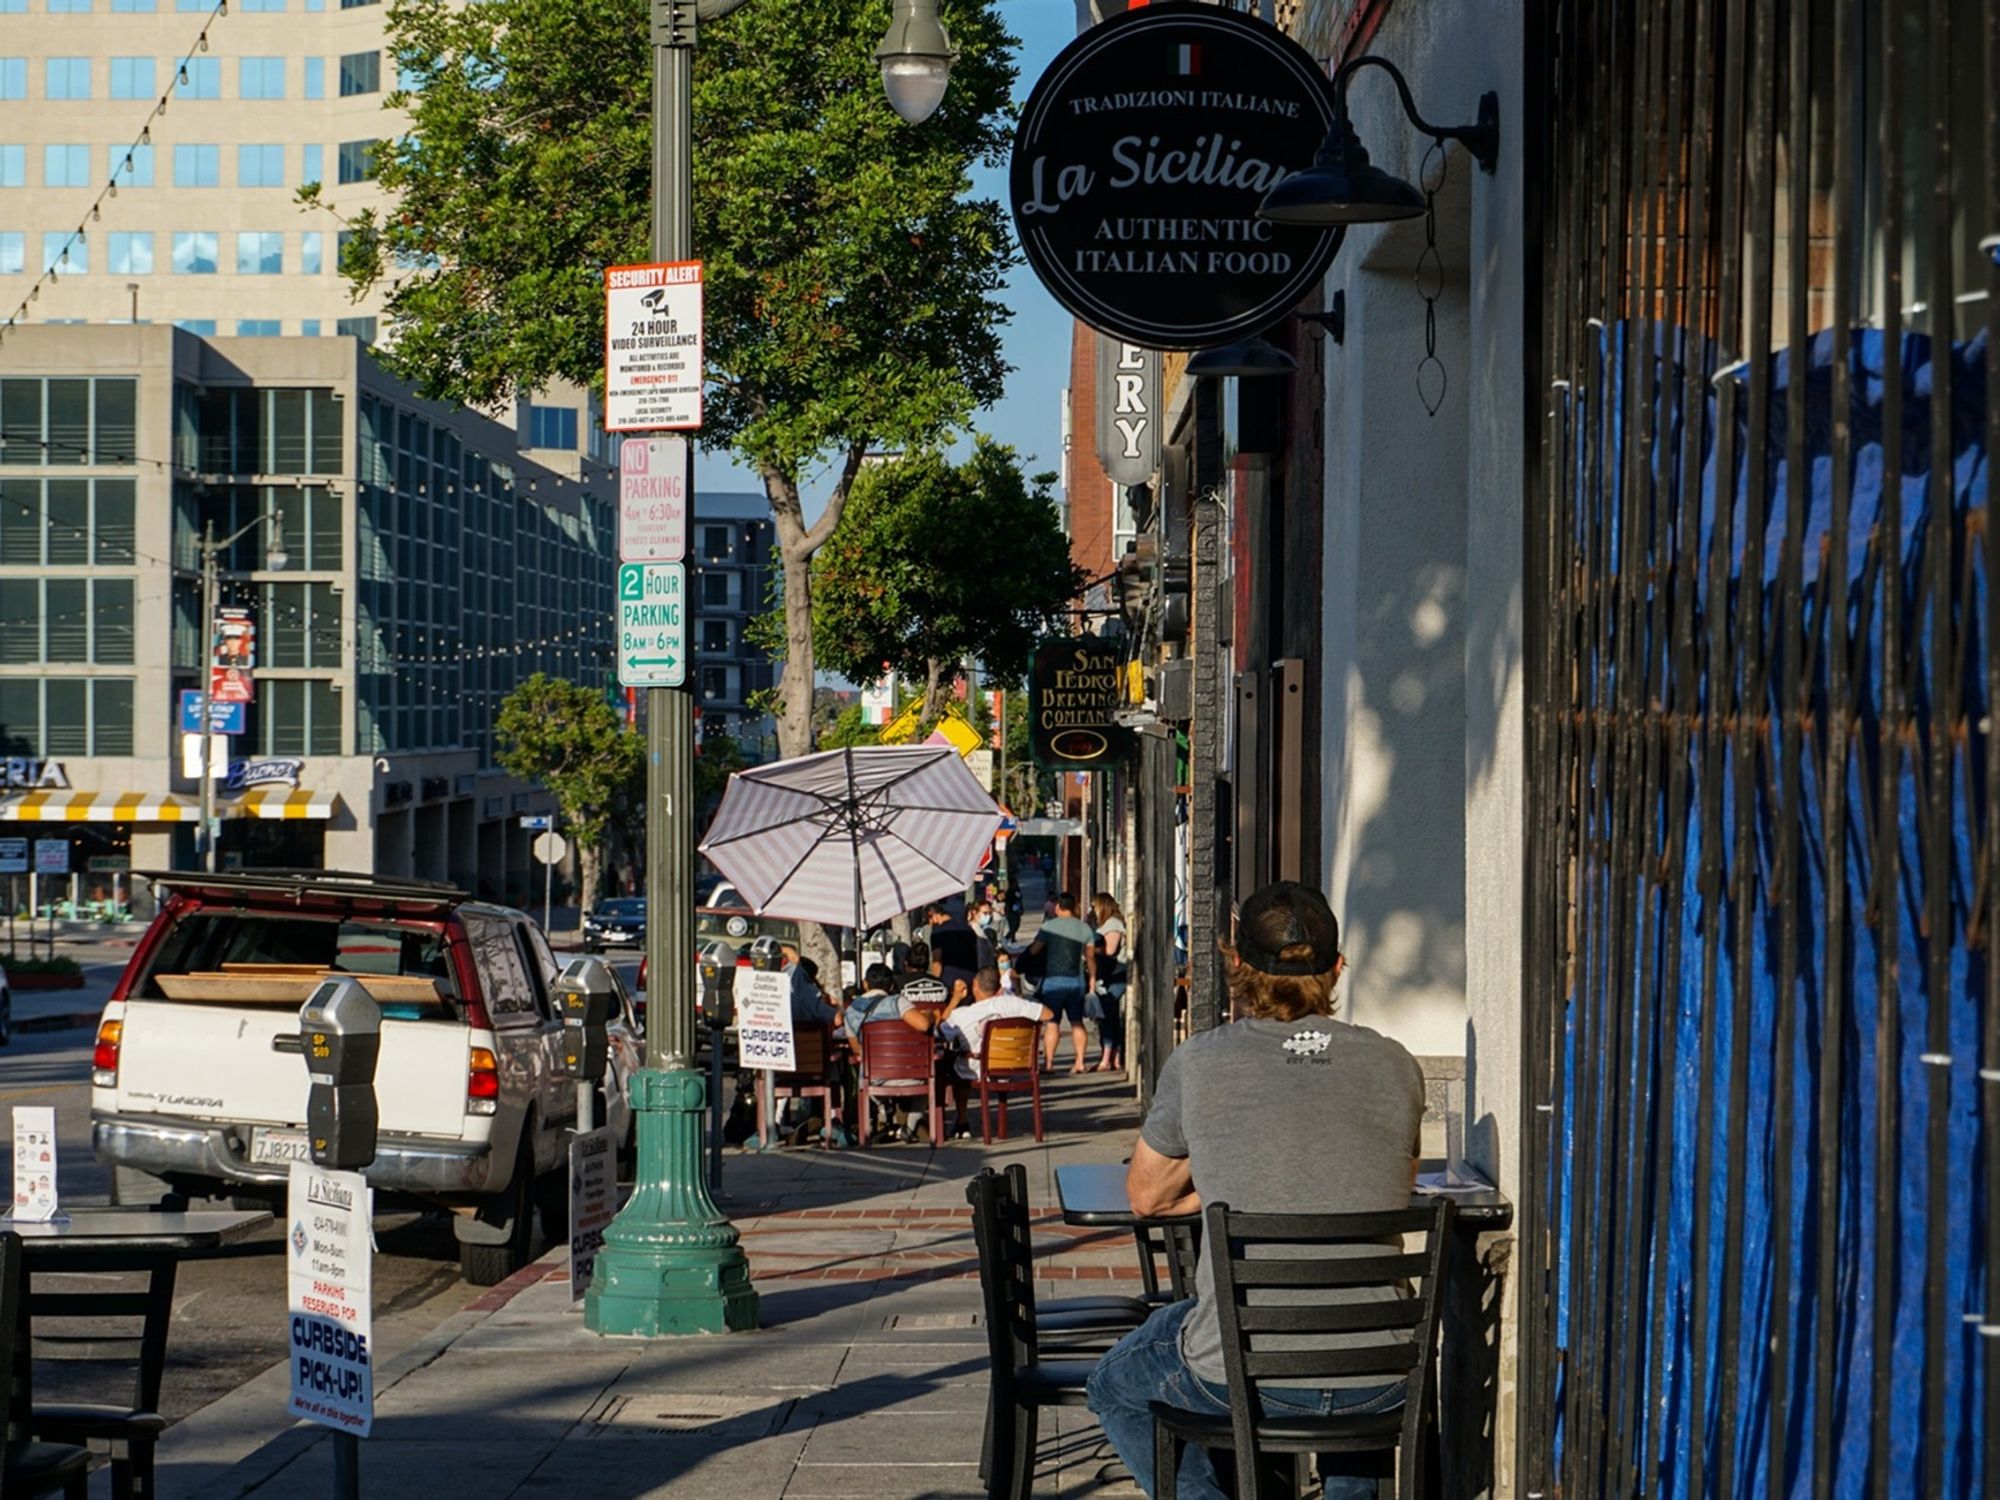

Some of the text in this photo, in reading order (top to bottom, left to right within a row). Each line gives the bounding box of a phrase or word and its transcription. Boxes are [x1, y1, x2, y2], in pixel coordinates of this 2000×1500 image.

[1069, 90, 1300, 118] TRADIZIONI ITALIANE
[1021, 132, 1300, 215] La Sicilian
[1094, 218, 1273, 242] AUTHENTIC
[1076, 251, 1291, 274] ITALIAN FOOD
[609, 266, 700, 288] SECURITY ALERT
[632, 319, 677, 336] 24 HOUR
[612, 334, 697, 350] VIDEO SURVEILLANCE
[630, 375, 666, 385] EMERGENCY
[625, 444, 645, 471] NO
[625, 476, 681, 499] PARKING
[624, 569, 679, 596] 2 HOUR
[624, 604, 679, 626] PARKING
[741, 1028, 791, 1044] CURBSIDE
[745, 1044, 788, 1058] PICK-UP!
[158, 1094, 224, 1108] TUNDRA
[308, 1176, 320, 1198] La
[313, 1281, 345, 1300] PARKING
[302, 1296, 357, 1321] RESERVED FOR
[293, 1317, 368, 1365] CURBSIDE
[299, 1357, 364, 1403] PICK-UP!
[340, 1411, 366, 1427] together
